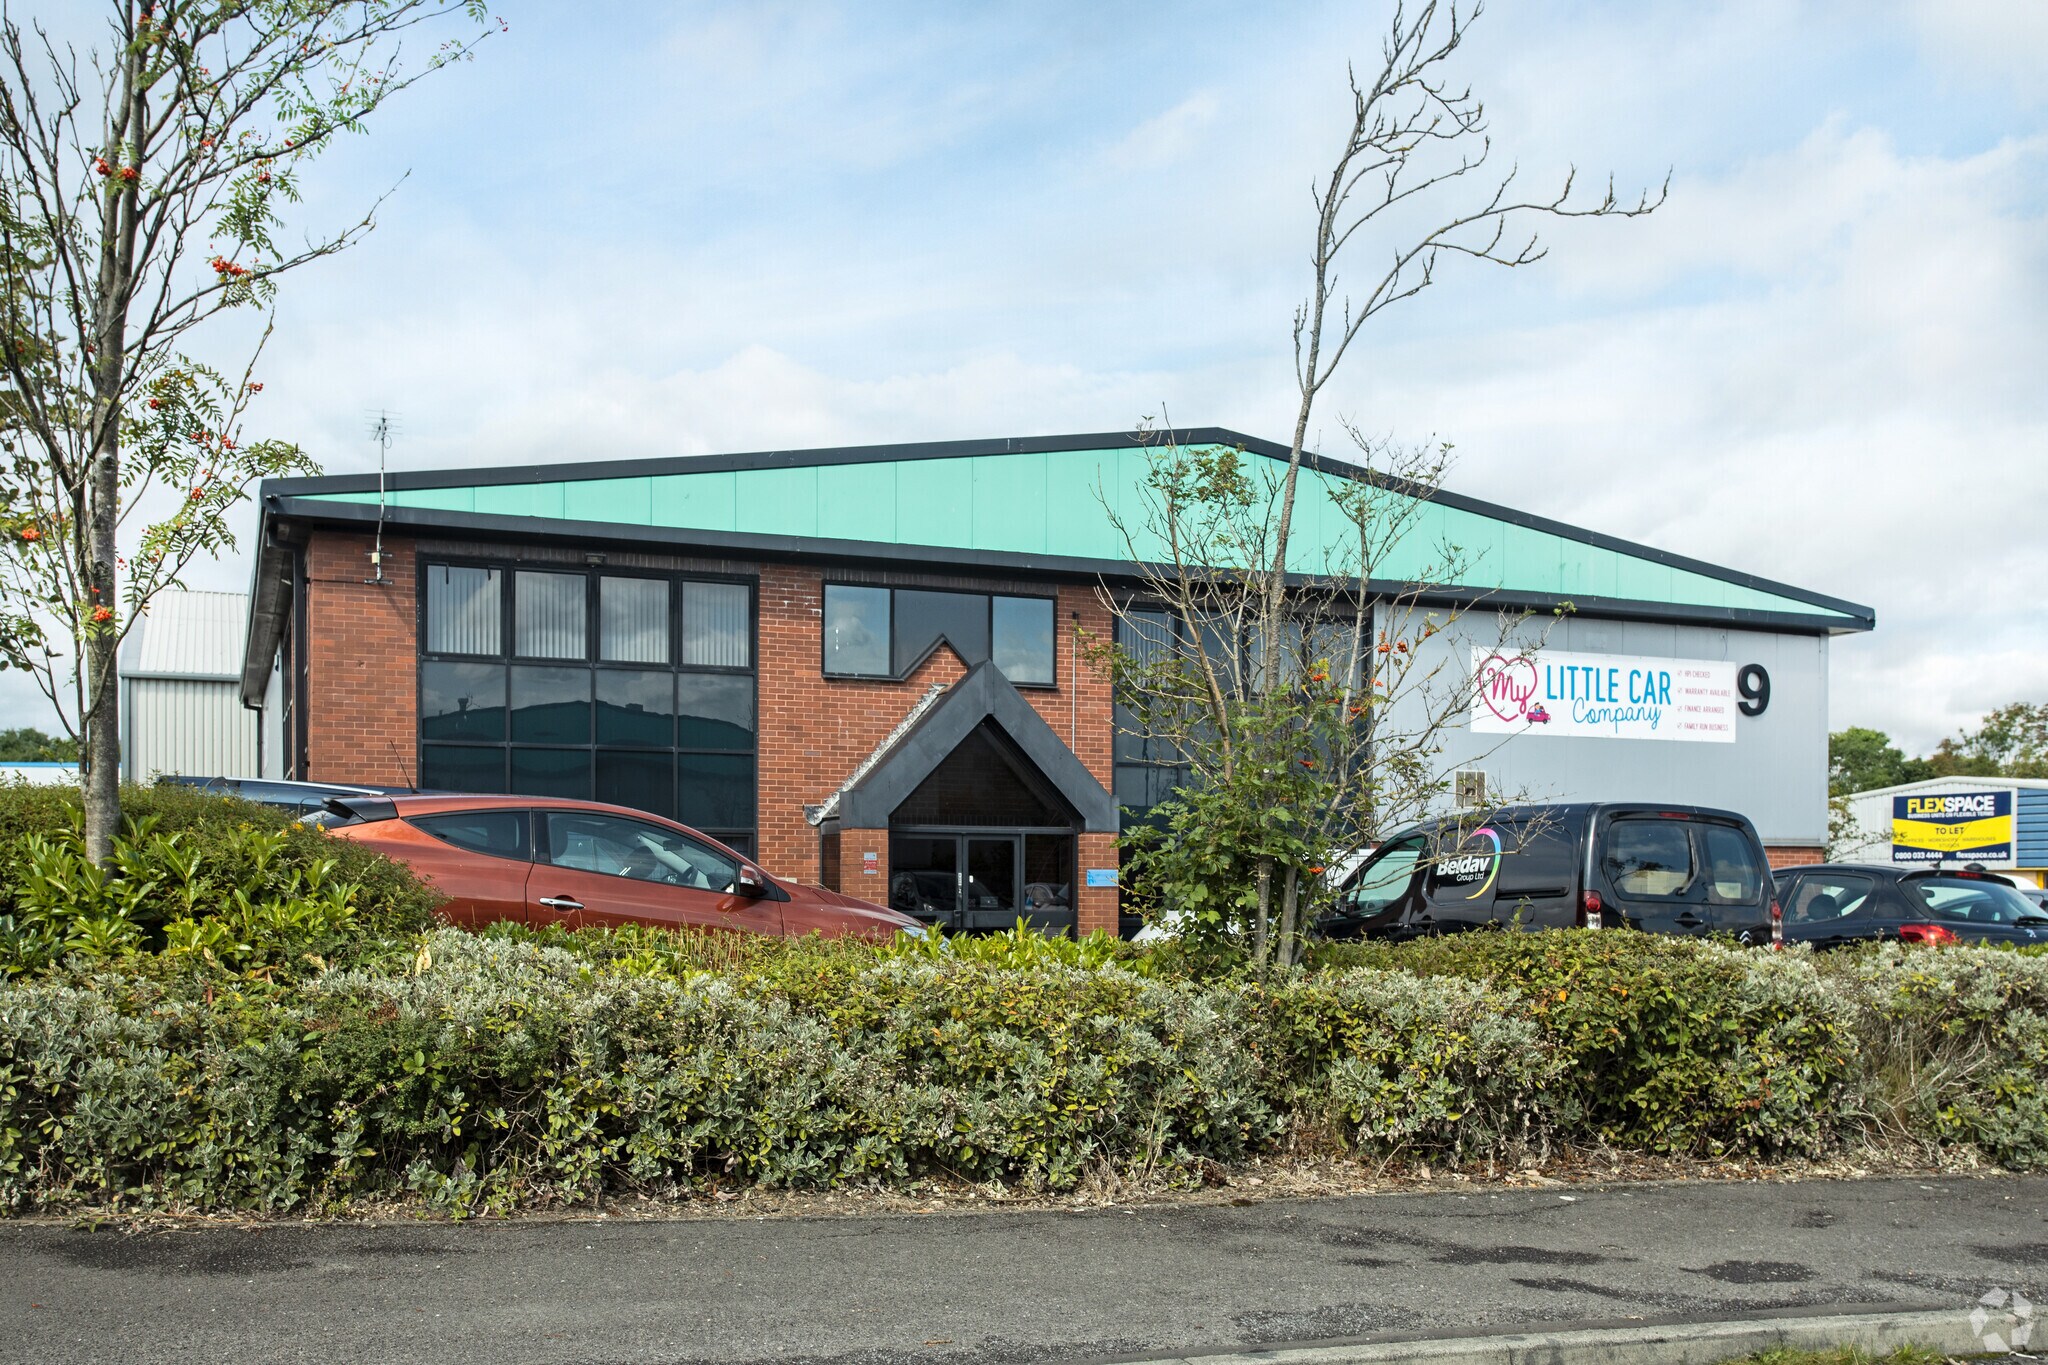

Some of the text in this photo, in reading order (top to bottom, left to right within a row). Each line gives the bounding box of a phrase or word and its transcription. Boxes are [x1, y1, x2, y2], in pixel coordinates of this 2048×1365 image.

[1487, 664, 1672, 715] My LITTLE CAR
[1709, 689, 1731, 697] AVAILABLE
[1737, 663, 1771, 717] 9
[1572, 696, 1662, 734] Company
[1907, 795, 1995, 813] FLEXSPACE
[1955, 851, 2007, 860] flexspace.co.uk
[1436, 855, 1491, 876] Beldav
[1456, 871, 1485, 882] Group Ltd
